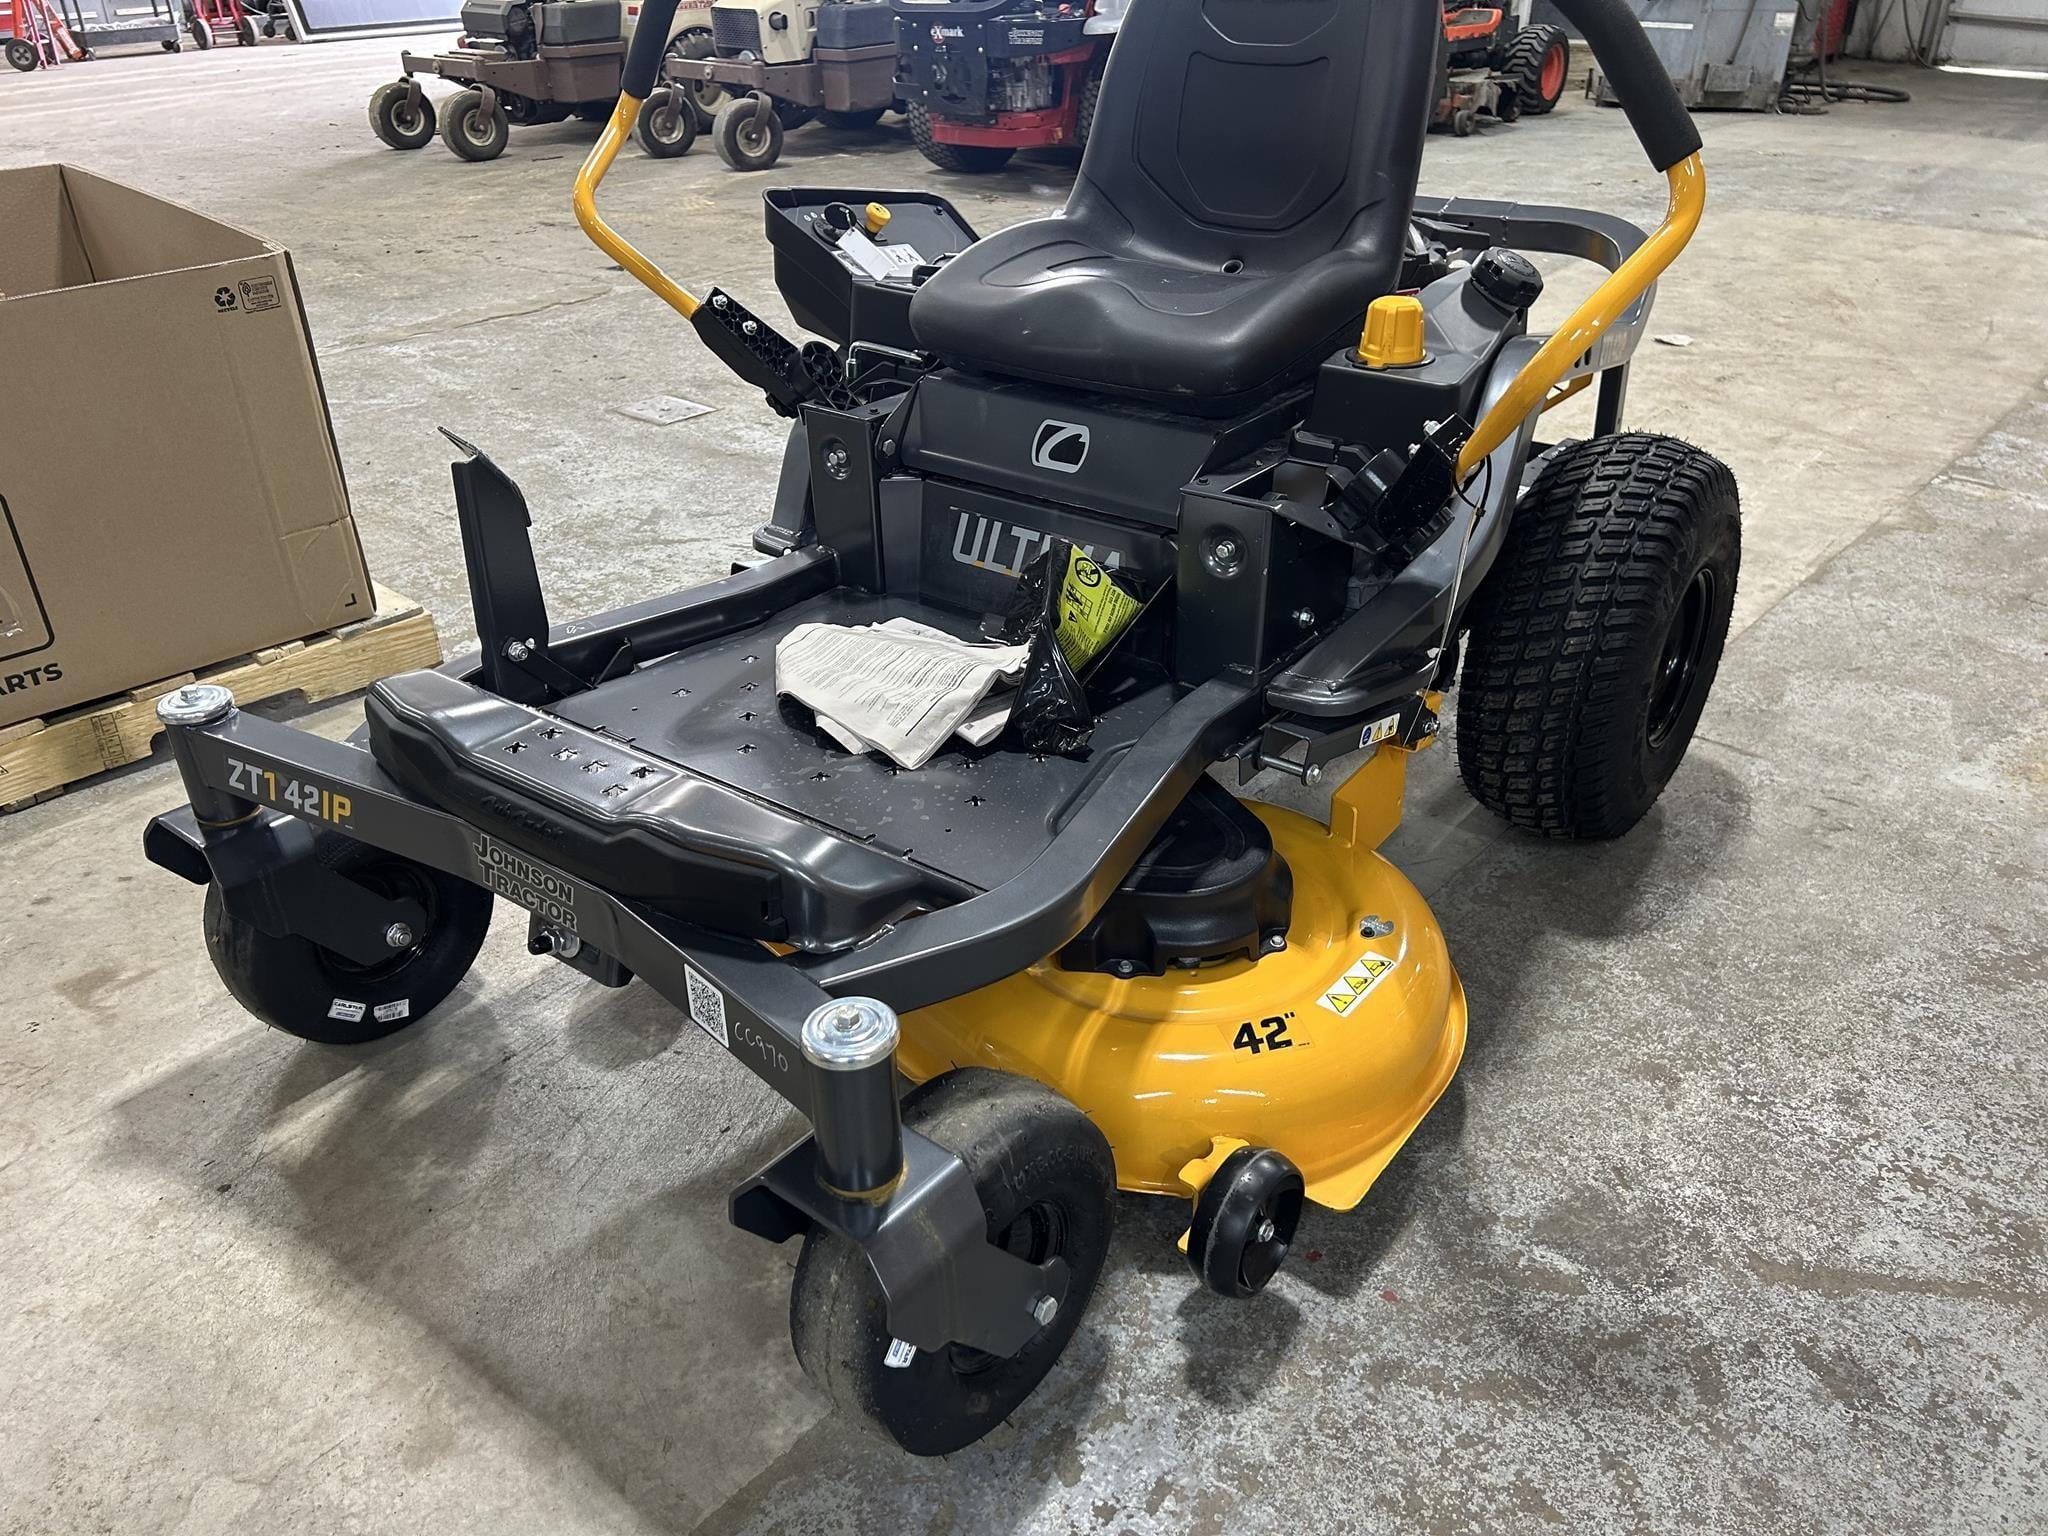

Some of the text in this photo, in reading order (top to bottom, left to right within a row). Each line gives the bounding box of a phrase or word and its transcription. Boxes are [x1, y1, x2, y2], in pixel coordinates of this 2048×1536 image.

[227, 757, 352, 824] ZT1 42IP
[472, 832, 575, 906] JOHNSON
[477, 856, 578, 933] TRACTOR
[1232, 1011, 1296, 1055] 42"
